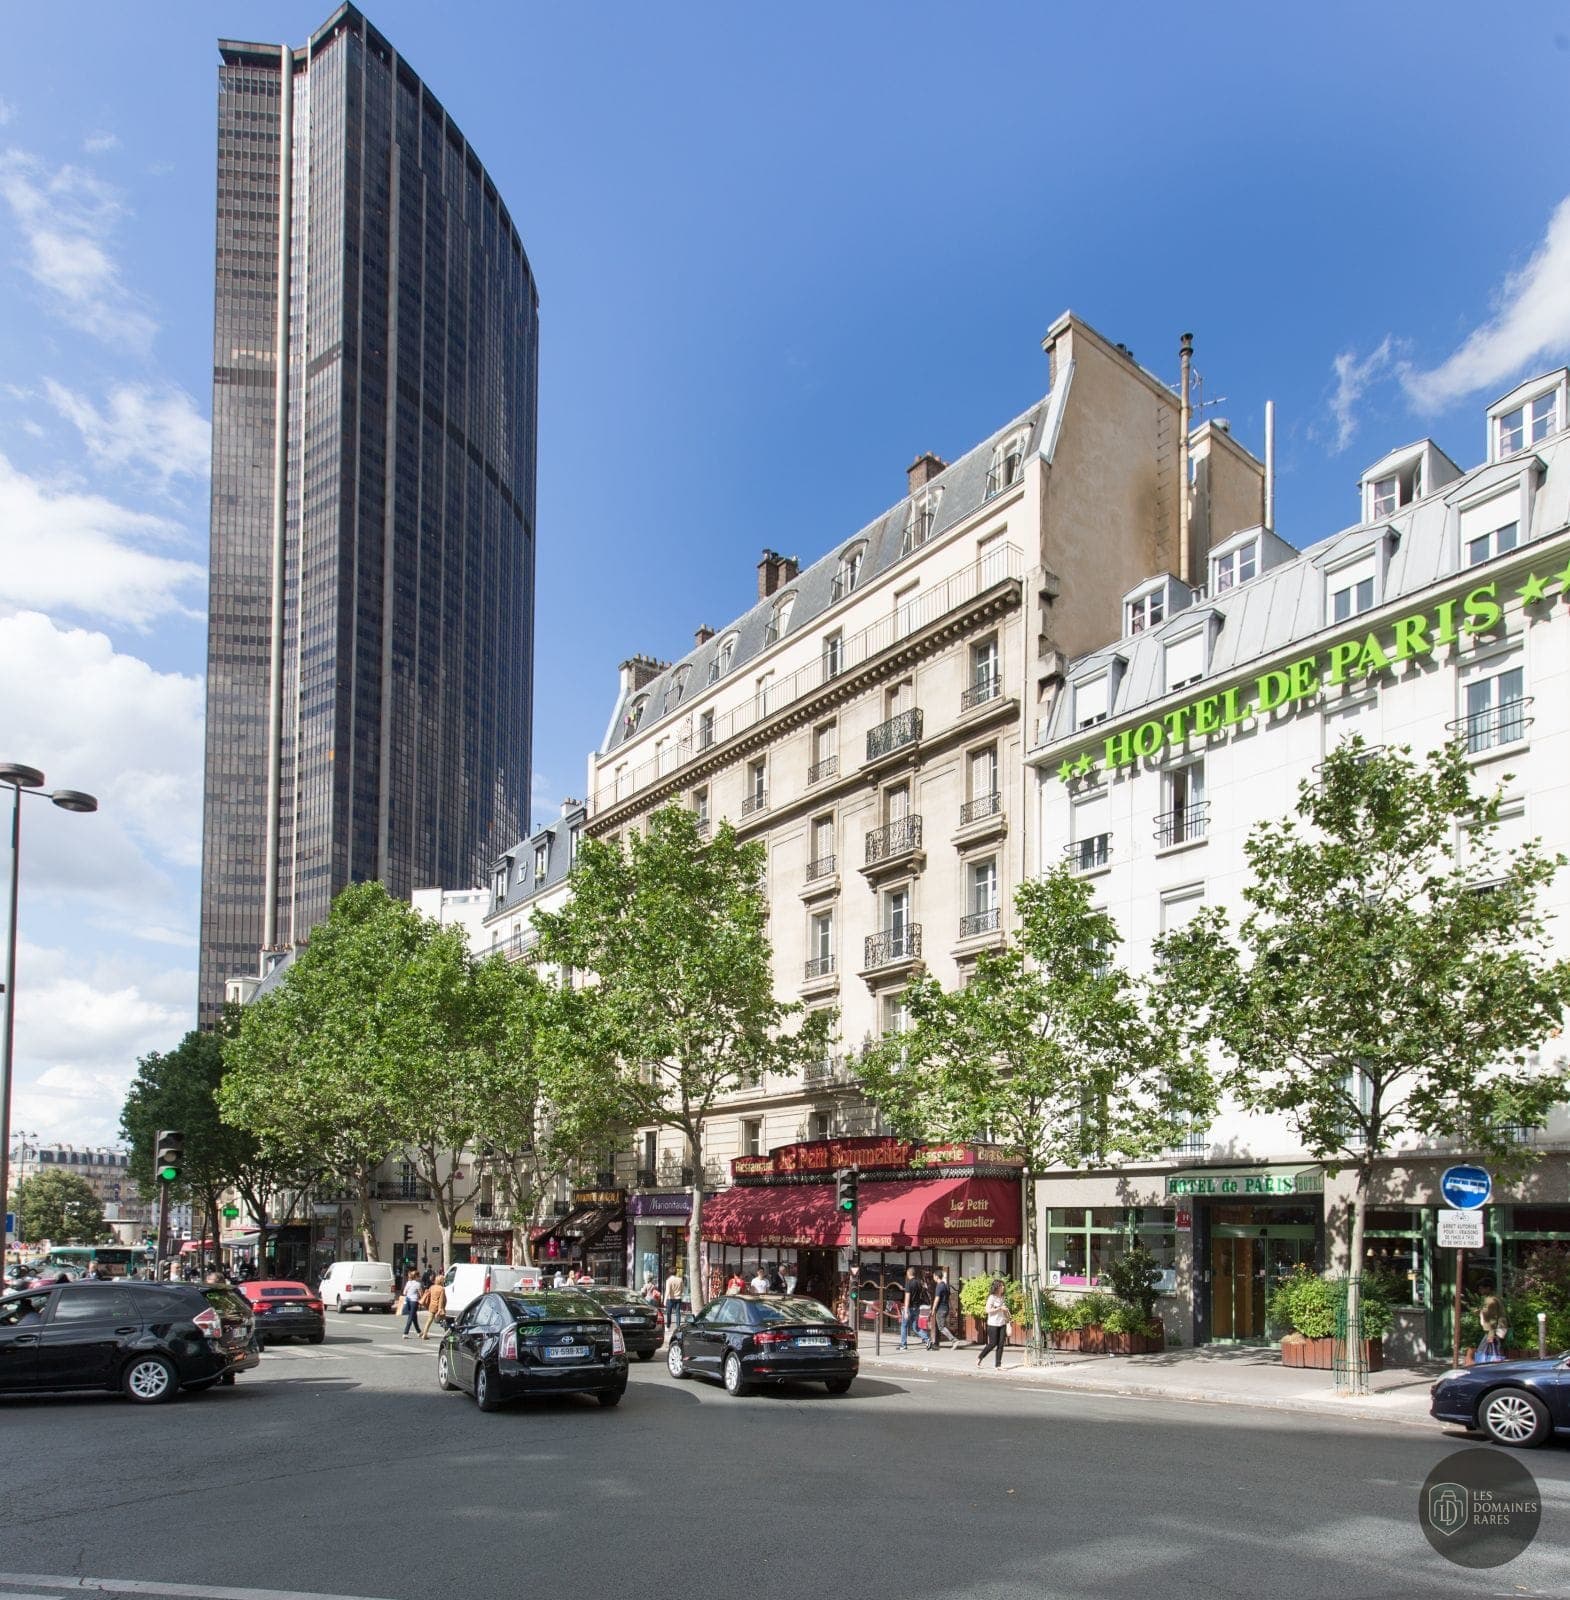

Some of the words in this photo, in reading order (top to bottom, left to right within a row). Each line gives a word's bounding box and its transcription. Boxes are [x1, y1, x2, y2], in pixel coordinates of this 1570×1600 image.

[1102, 687, 1253, 770] HOTEL
[1255, 656, 1321, 713] DE
[1327, 581, 1502, 686] PARIS
[1169, 1179, 1215, 1193] HOTEL
[1222, 1179, 1238, 1192] de
[1245, 1177, 1292, 1192] PARIS
[950, 1199, 965, 1211] Le
[967, 1198, 989, 1211] Petit
[943, 1216, 995, 1229] Sommelier
